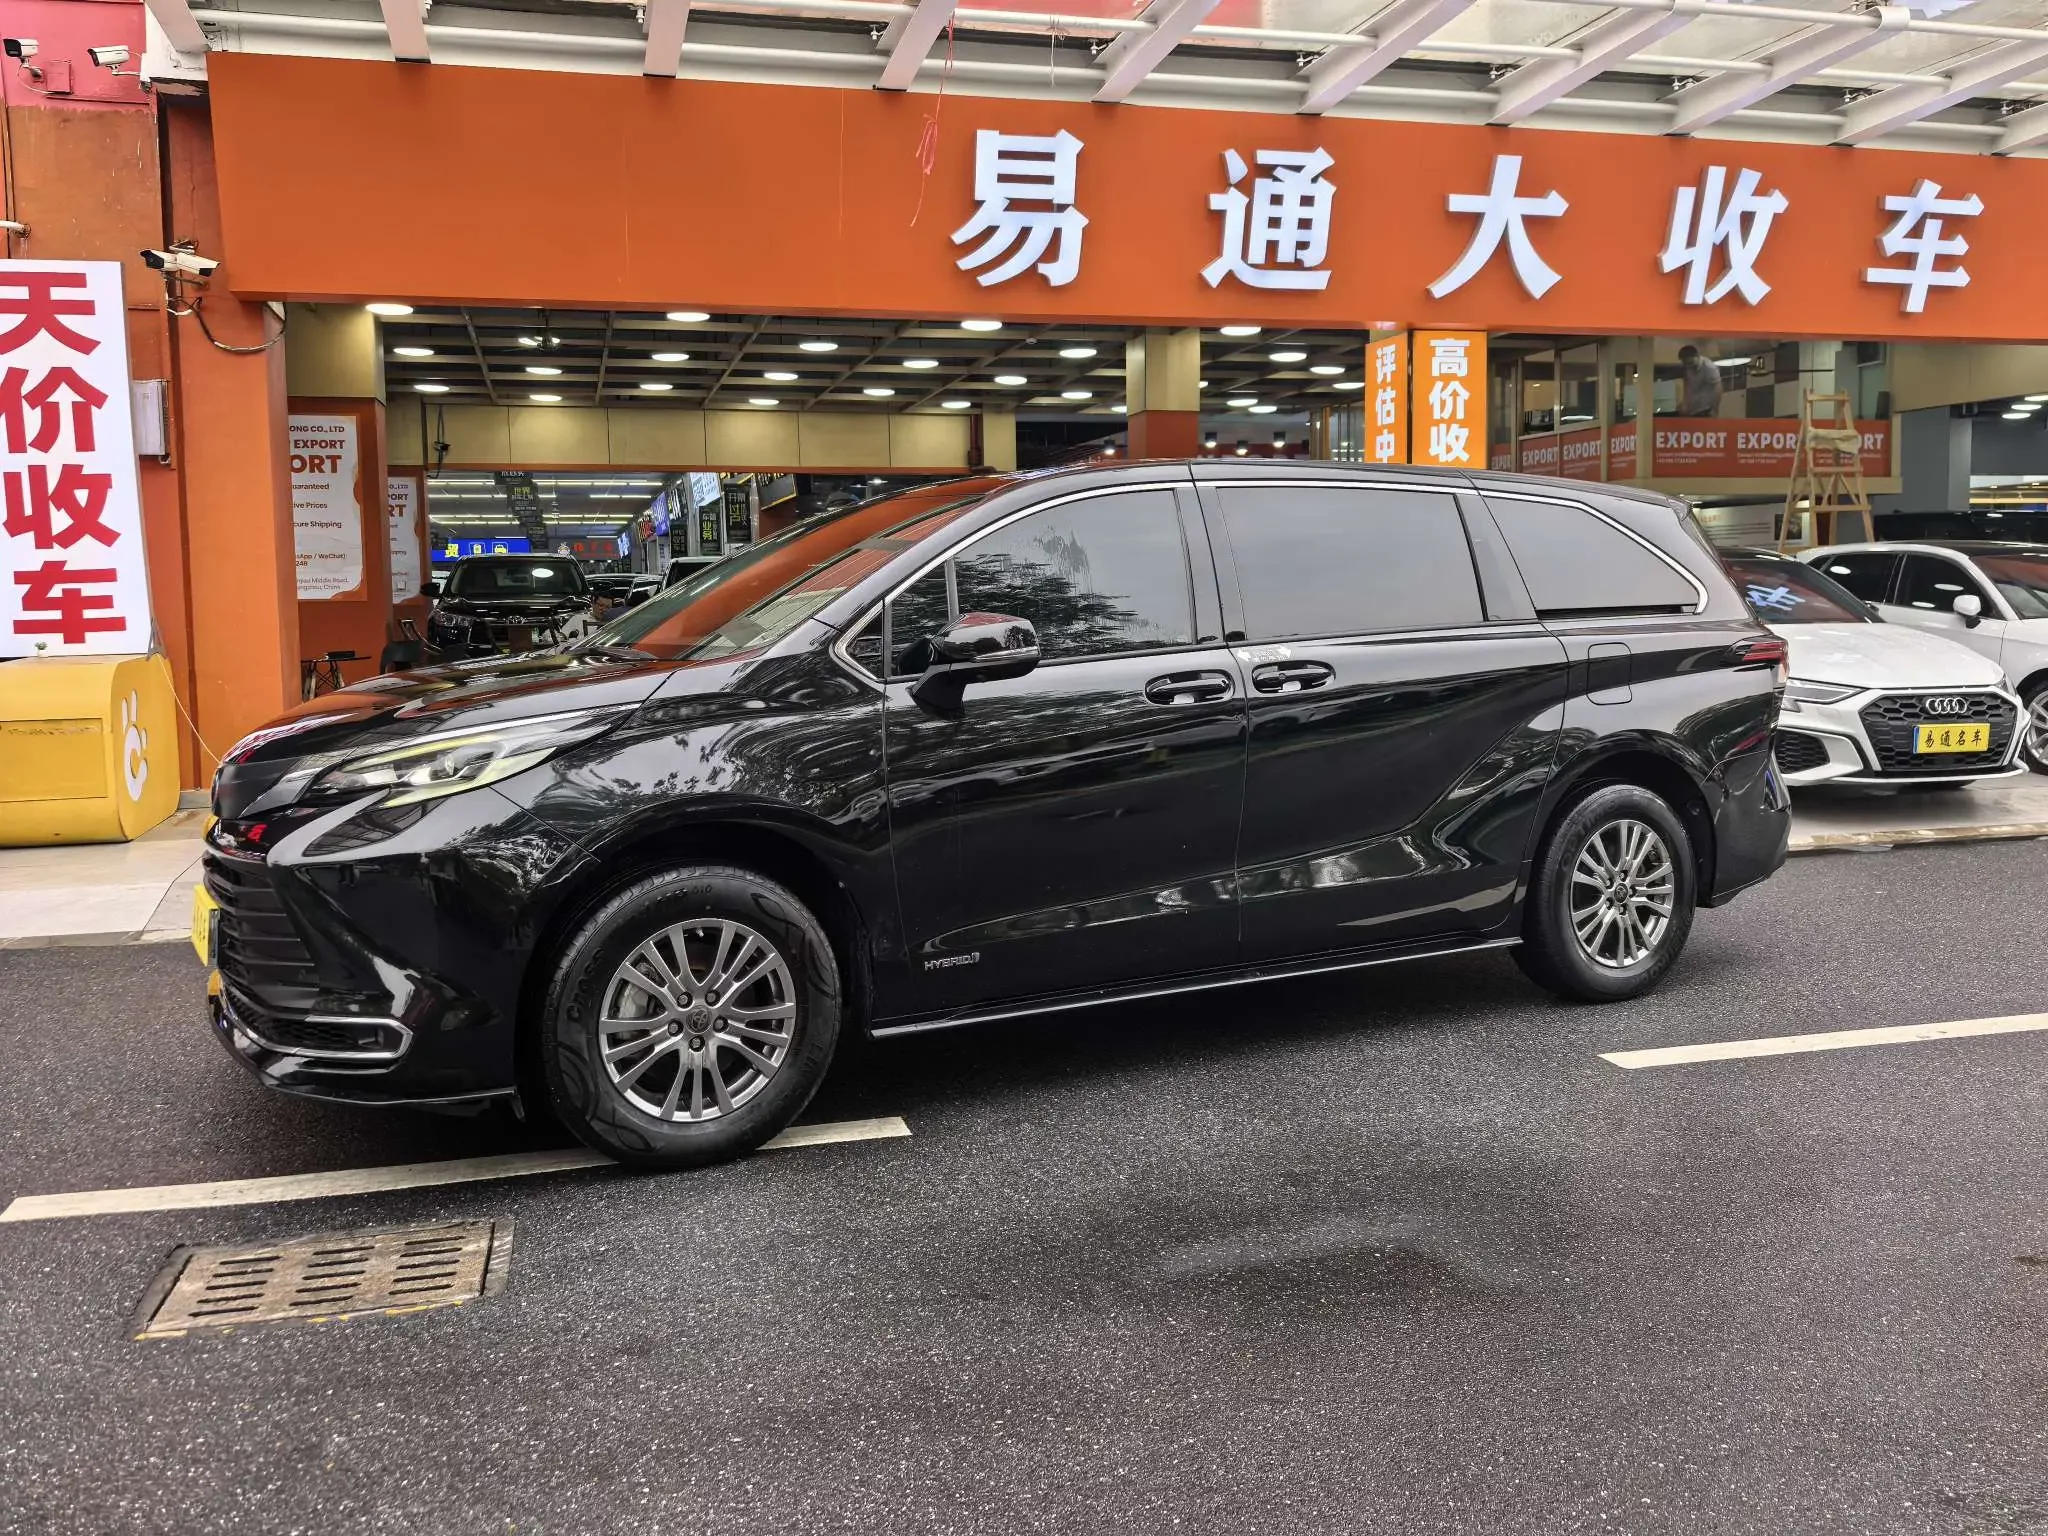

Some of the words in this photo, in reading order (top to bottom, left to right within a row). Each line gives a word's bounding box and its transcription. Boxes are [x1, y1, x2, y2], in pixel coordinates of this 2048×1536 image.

[951, 128, 1984, 315] 易通大收车
[1375, 343, 1396, 463] 评估中
[1428, 338, 1470, 462] 高价收
[329, 425, 345, 433] LTD
[294, 440, 345, 449] EXPORT
[1562, 439, 1601, 460] EXPORT
[1655, 431, 1728, 449] EXPORT
[1736, 432, 1799, 450] EXPOR
[0, 271, 127, 643] 天价收车
[290, 455, 342, 474] ORT
[310, 520, 342, 528] Shipping
[1925, 729, 1981, 748] 易通名车
[924, 955, 972, 971] HYBRID
